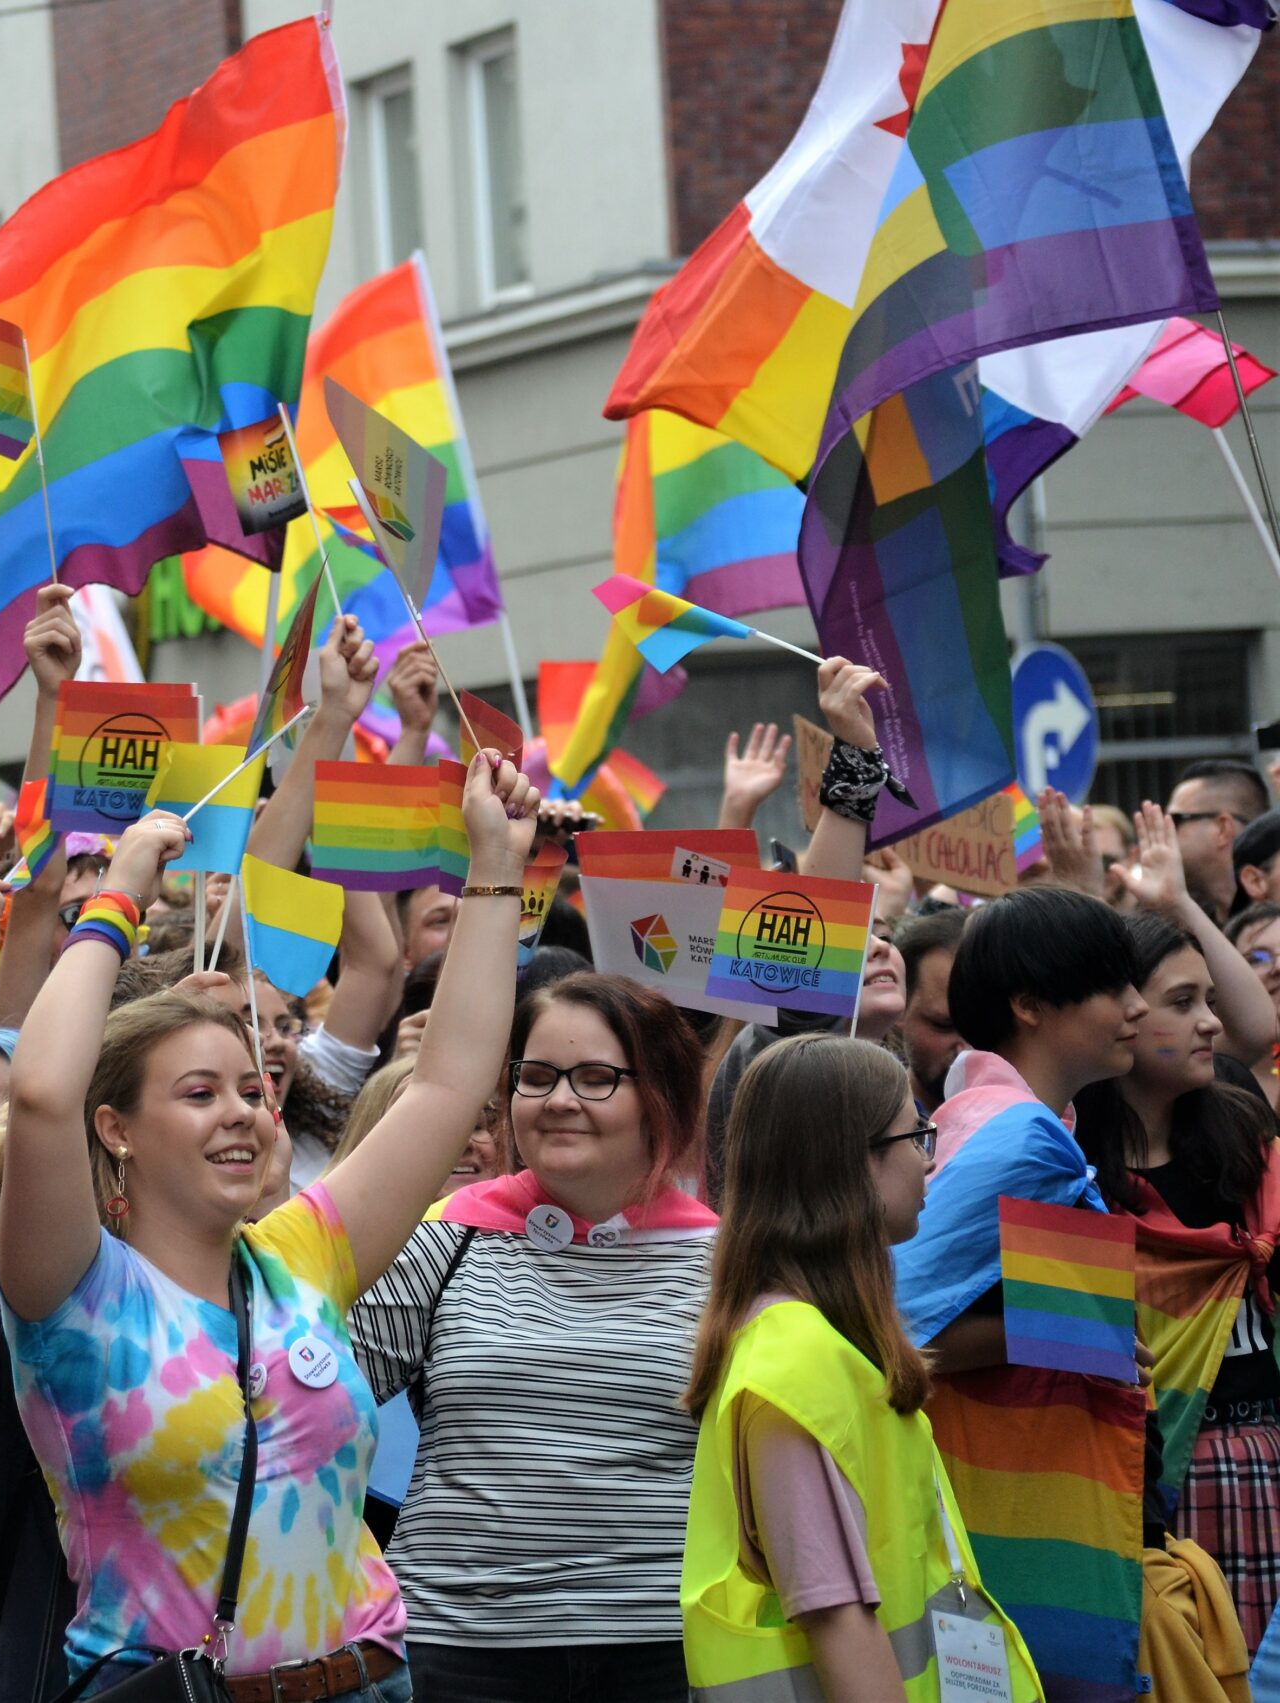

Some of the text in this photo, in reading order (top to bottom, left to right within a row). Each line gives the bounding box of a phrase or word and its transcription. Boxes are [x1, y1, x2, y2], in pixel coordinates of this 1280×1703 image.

[99, 737, 160, 771] HAH
[689, 934, 716, 946] MARS
[756, 911, 812, 947] HAH
[690, 944, 714, 955] RÓW
[729, 959, 822, 988] KATOWICE
